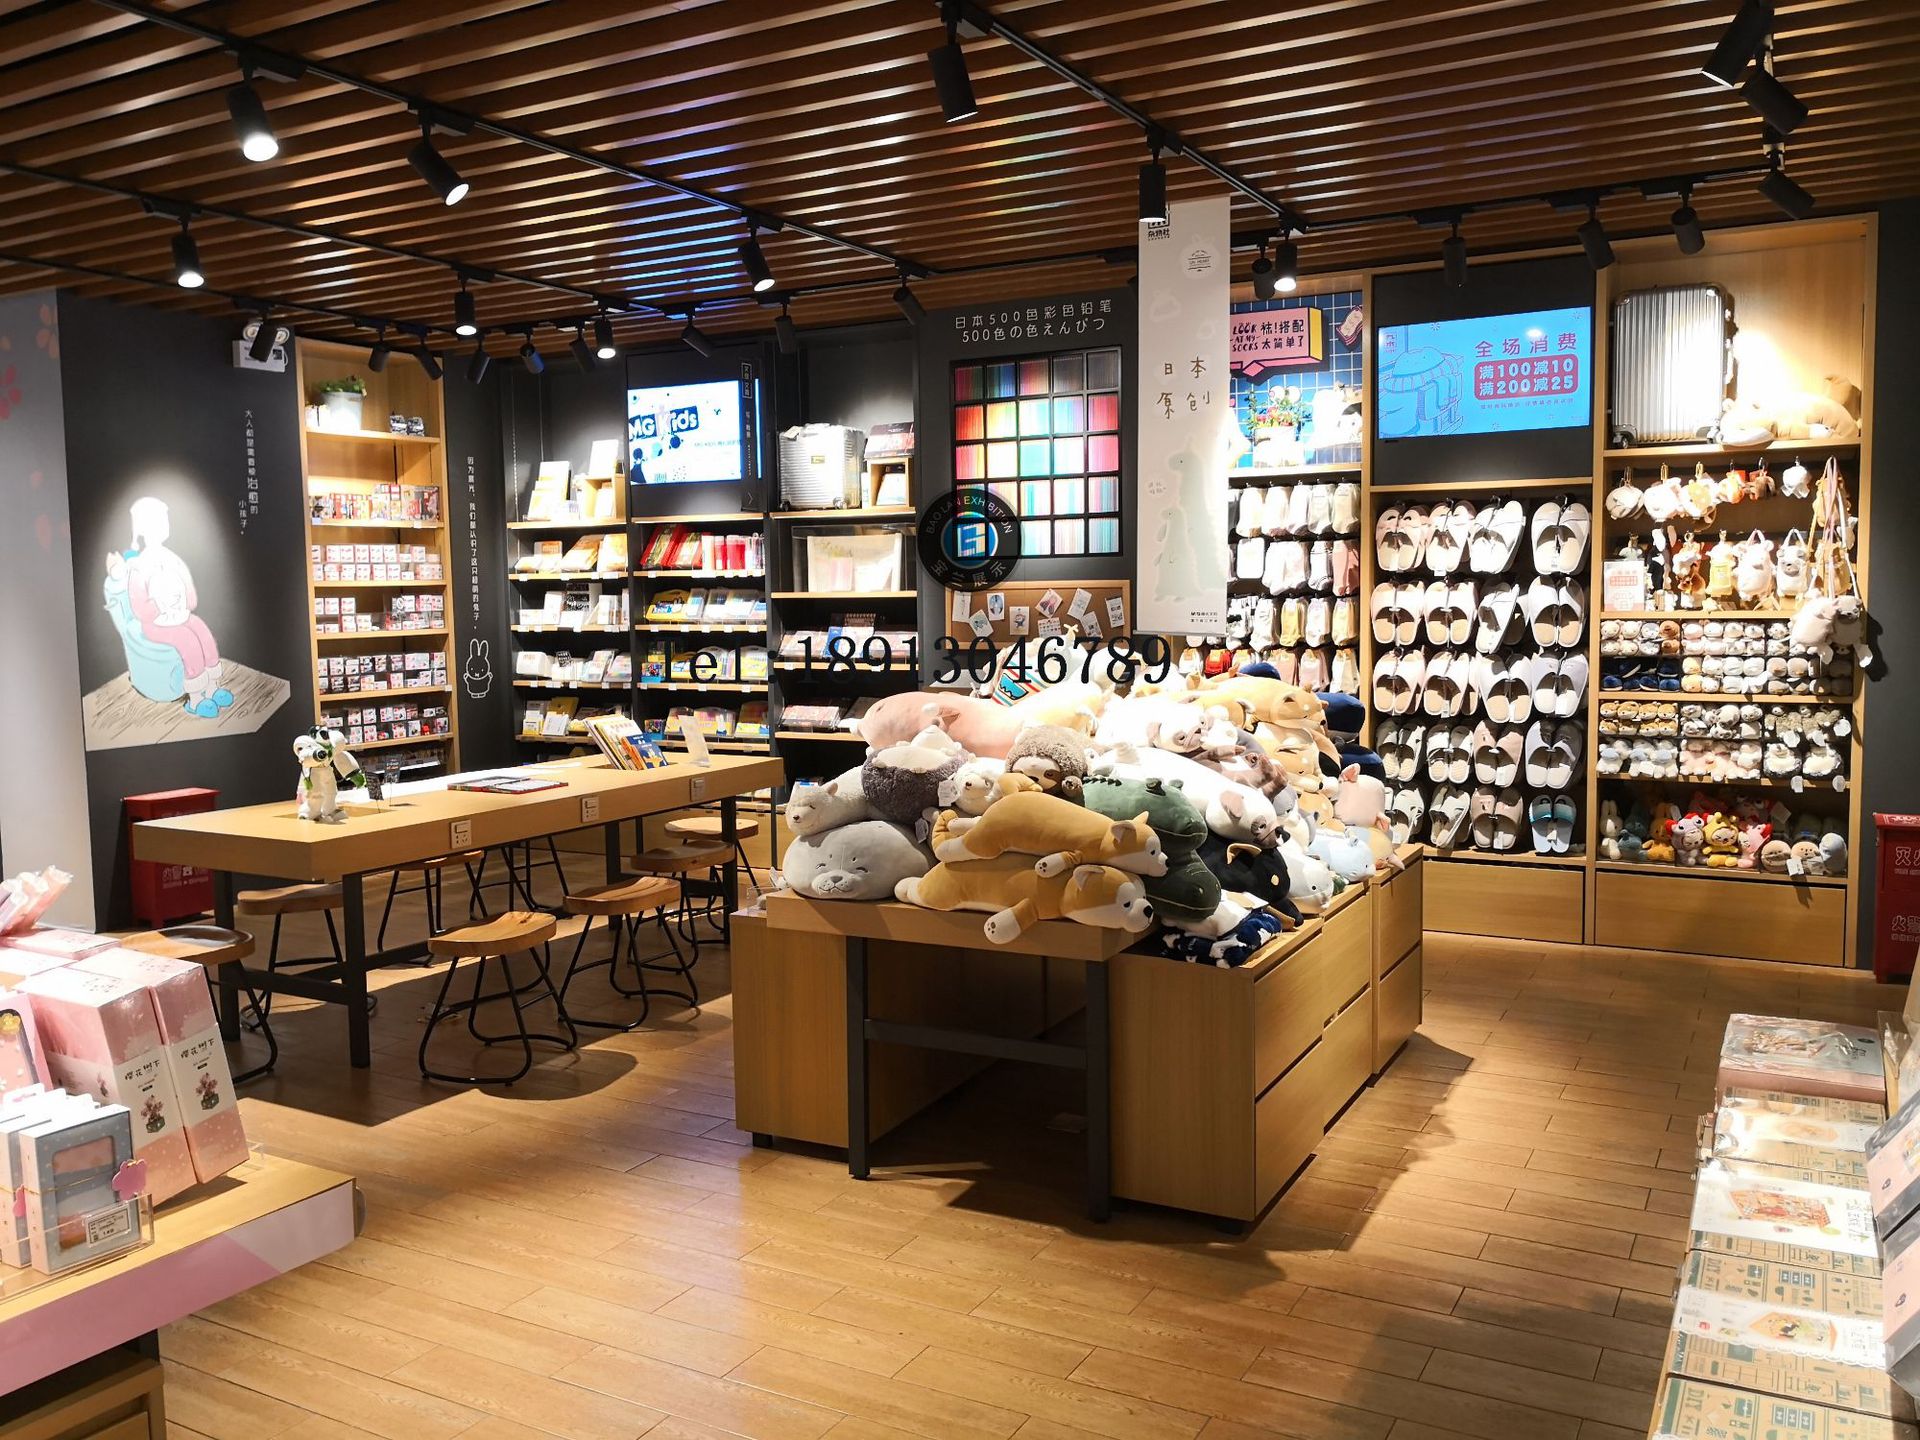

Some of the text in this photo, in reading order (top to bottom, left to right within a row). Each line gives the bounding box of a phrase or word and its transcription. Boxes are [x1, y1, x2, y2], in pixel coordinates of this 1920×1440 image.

[955, 299, 1112, 329] 日本500色彩色铅笔
[962, 318, 1105, 343] 500色の色えんぴつ
[1232, 322, 1258, 335] LOOK
[1232, 342, 1259, 352] SOCKS
[1261, 335, 1305, 350] 太简单了
[1475, 332, 1578, 358] 全场消费
[1164, 356, 1206, 378] 日本
[1479, 358, 1574, 380] 满100减10
[1479, 375, 1574, 397] 满200减25
[1156, 391, 1210, 419] 原创
